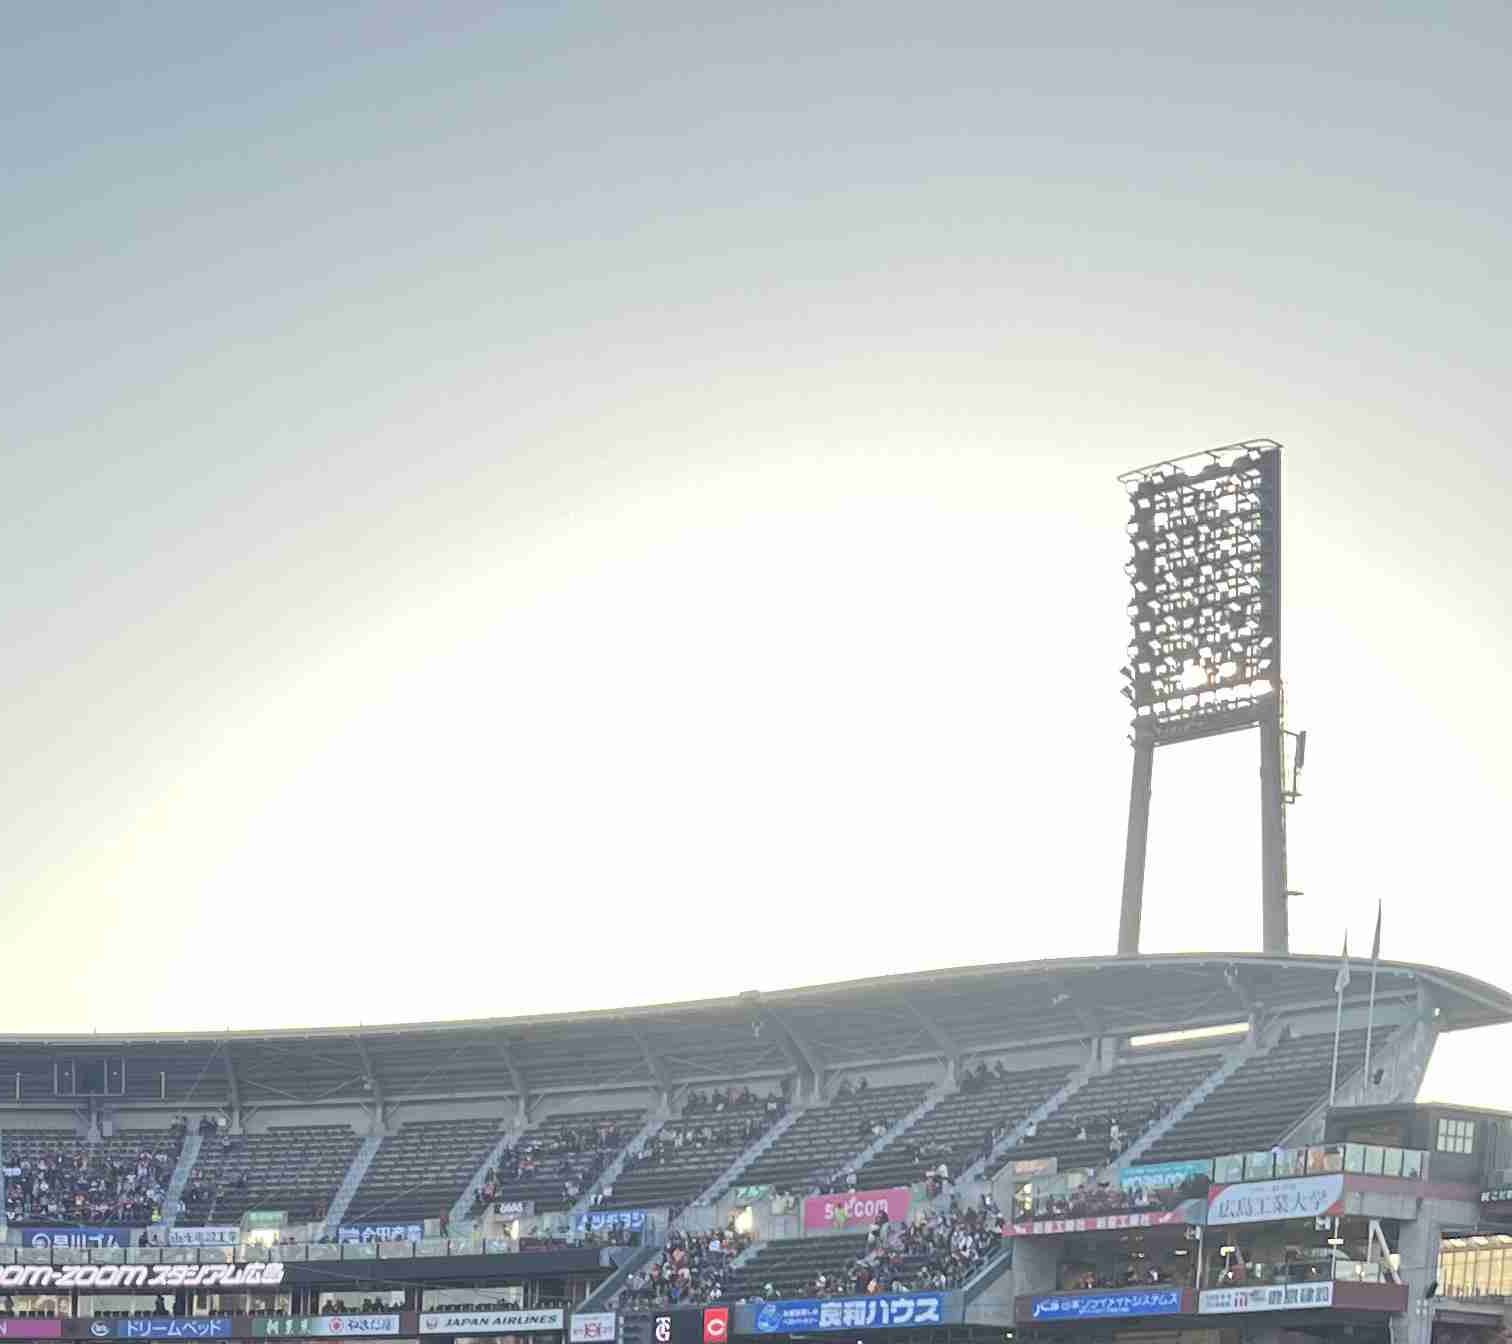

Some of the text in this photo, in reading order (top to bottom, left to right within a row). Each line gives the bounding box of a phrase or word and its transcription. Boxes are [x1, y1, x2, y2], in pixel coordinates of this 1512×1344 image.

[148, 1263, 285, 1286] スタジアム広島
[444, 1314, 557, 1328] JAPAN AIRLINES
[818, 1297, 940, 1327] 良和ハウス
[127, 1319, 222, 1337] ドリームベッド
